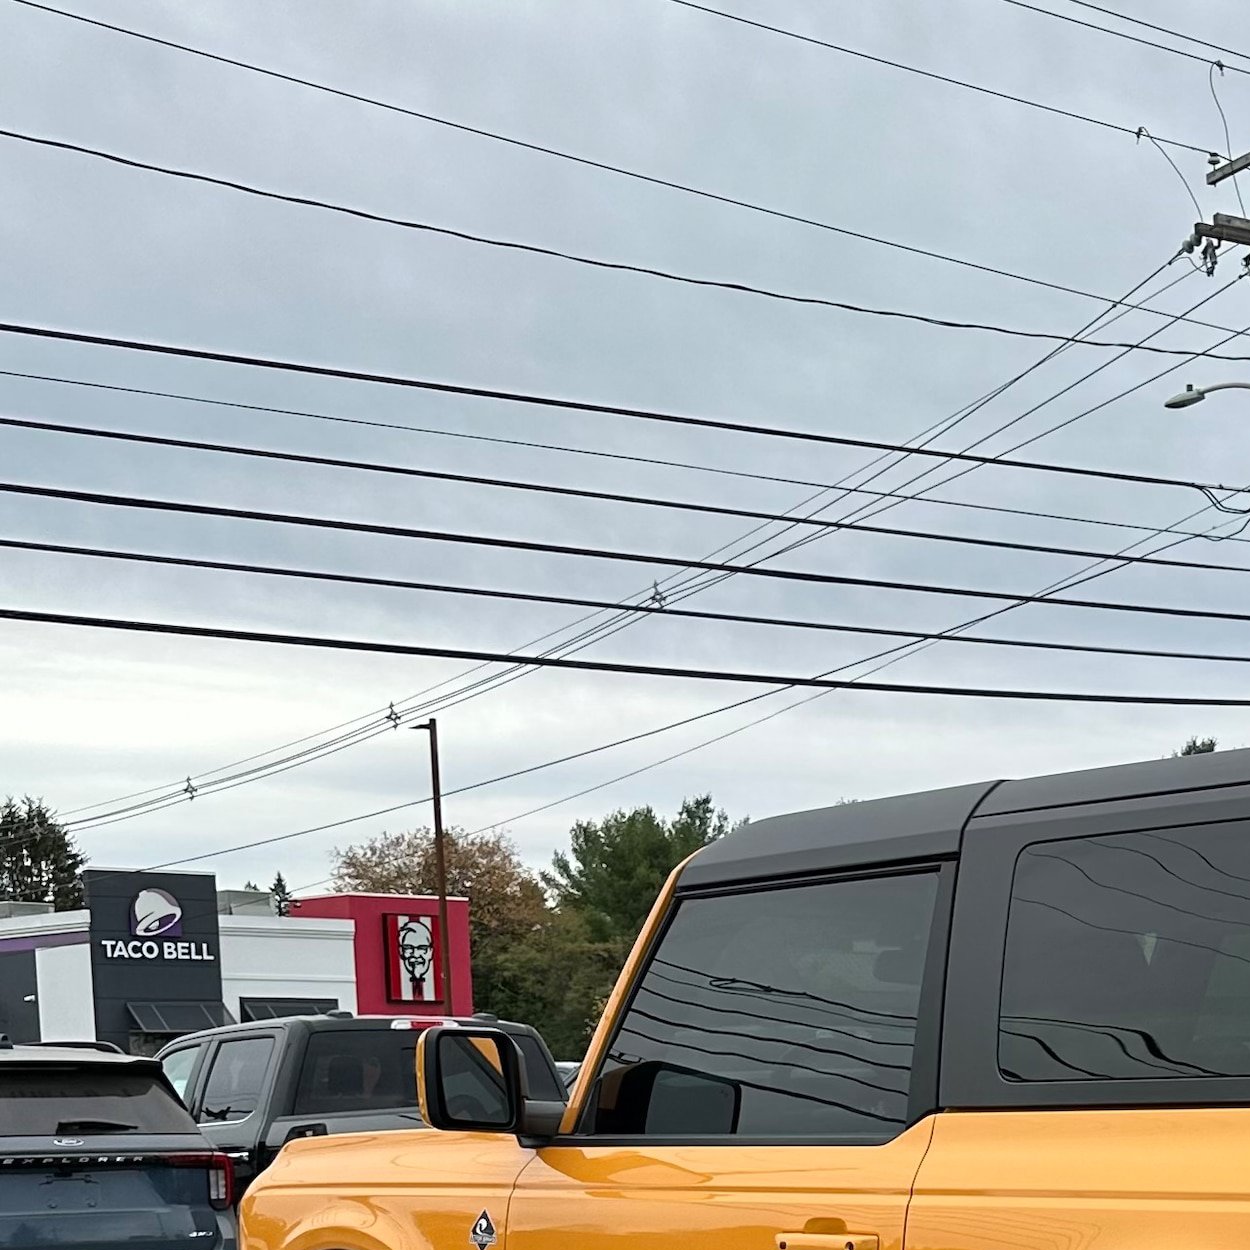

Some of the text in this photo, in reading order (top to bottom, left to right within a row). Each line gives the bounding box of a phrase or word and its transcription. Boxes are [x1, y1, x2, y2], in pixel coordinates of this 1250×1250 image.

[101, 940, 214, 960] TACO BELL
[3, 1156, 143, 1164] EXPLORER
